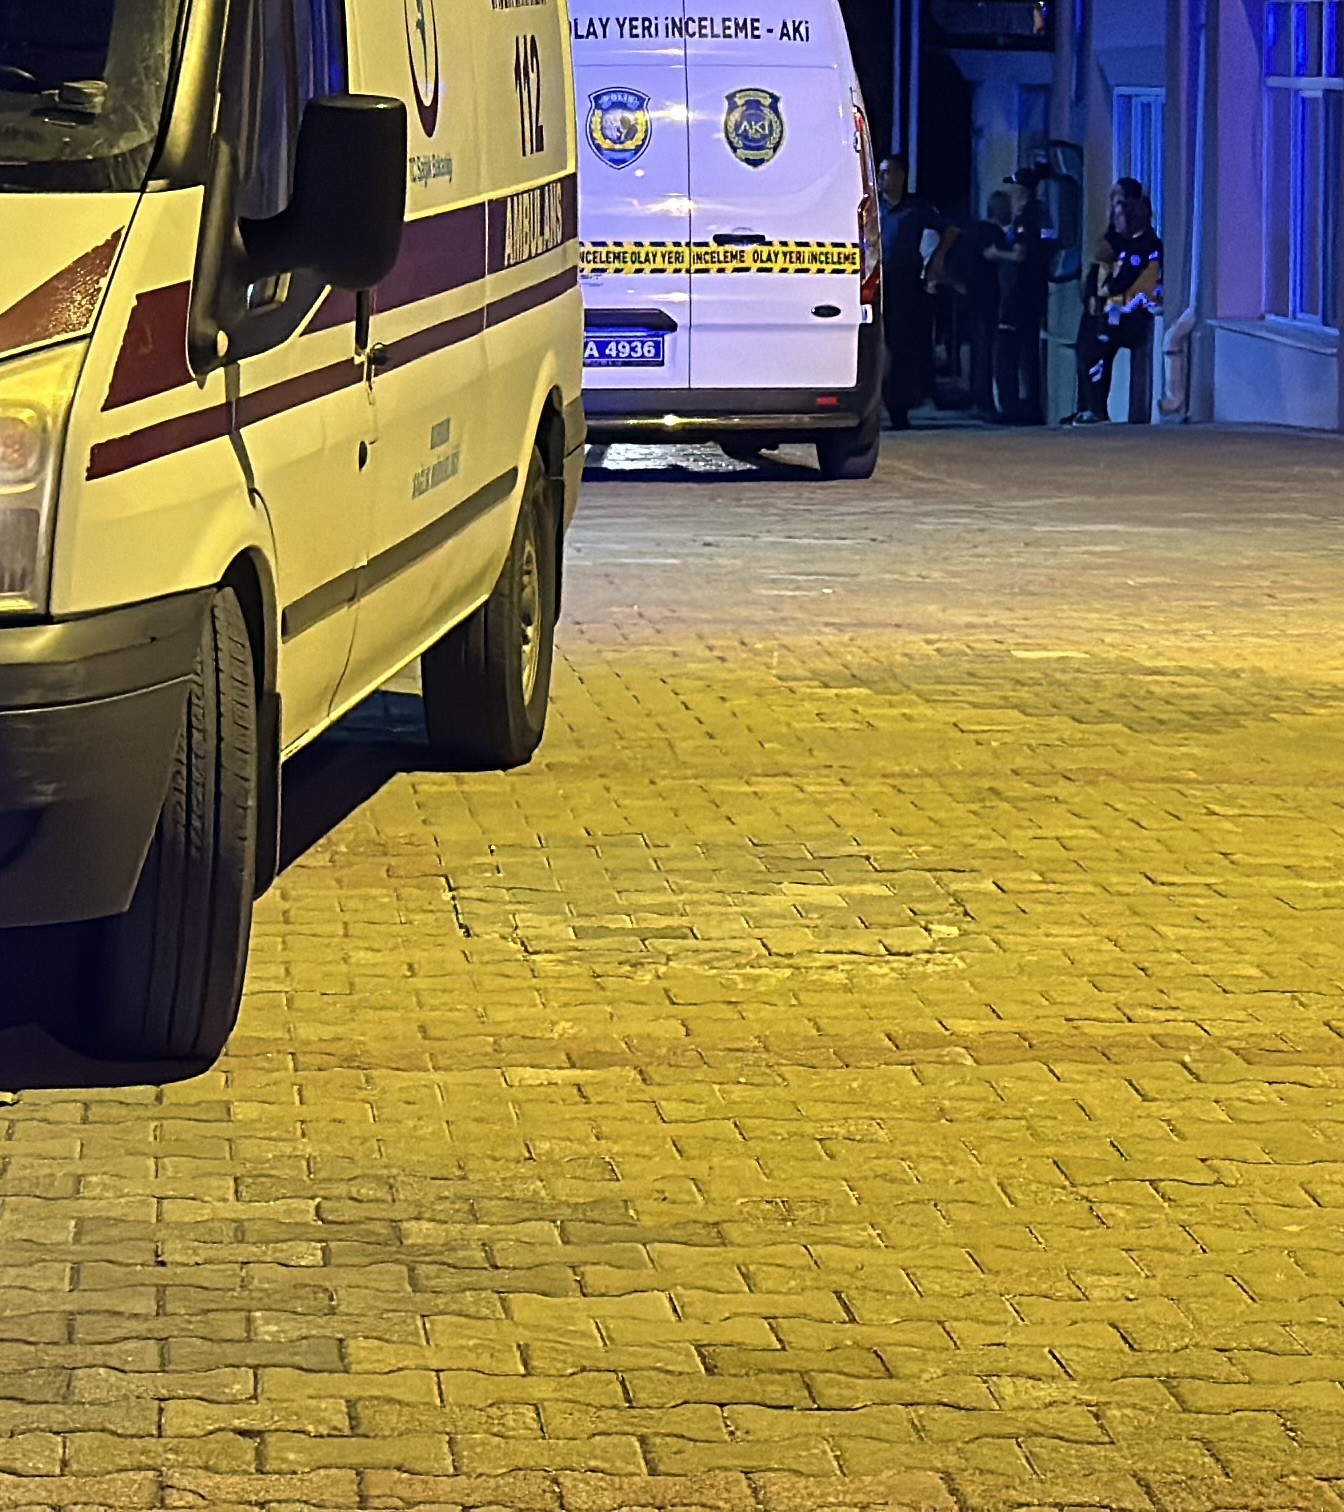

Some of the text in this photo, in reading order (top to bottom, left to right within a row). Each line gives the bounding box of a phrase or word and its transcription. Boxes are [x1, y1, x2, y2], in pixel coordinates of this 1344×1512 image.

[569, 17, 610, 40] LAY
[514, 34, 544, 157] 112
[504, 182, 563, 267] AMBULANS
[630, 250, 658, 265] OLAY
[752, 249, 780, 264] OLAY
[583, 340, 656, 358] A 4936
